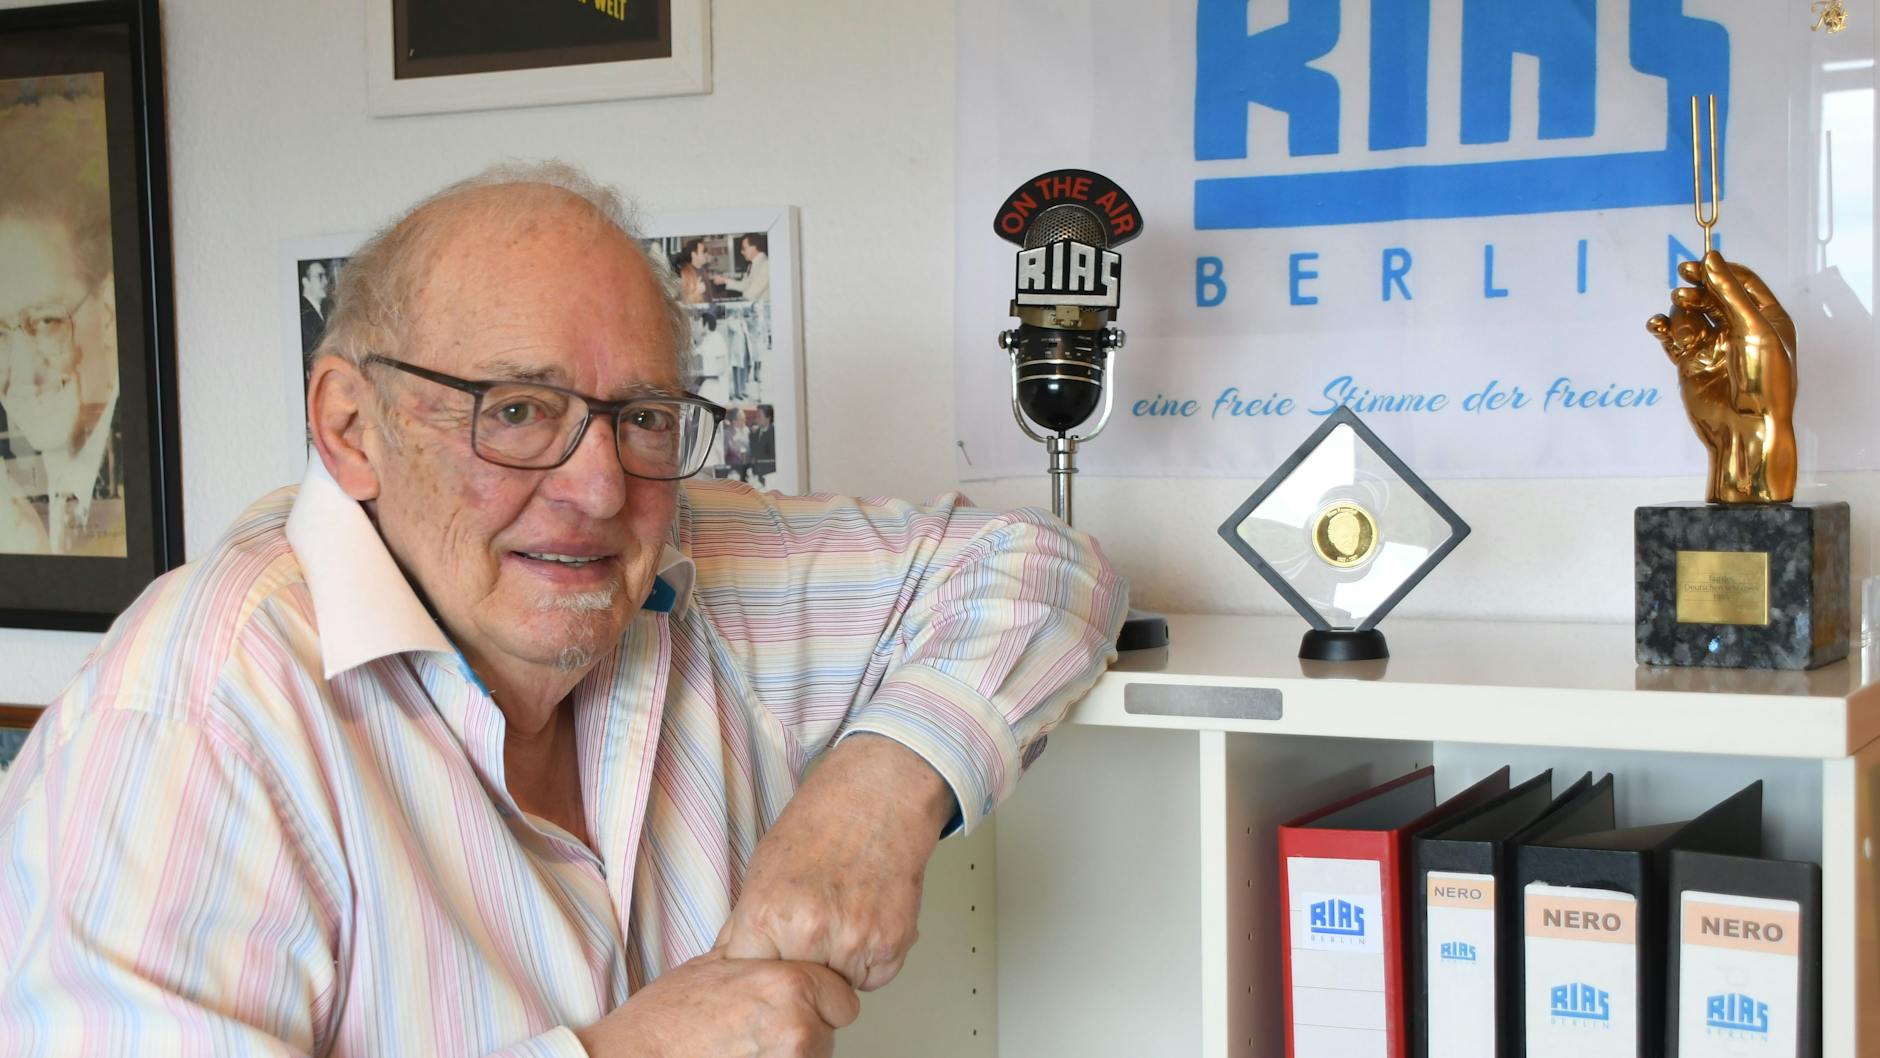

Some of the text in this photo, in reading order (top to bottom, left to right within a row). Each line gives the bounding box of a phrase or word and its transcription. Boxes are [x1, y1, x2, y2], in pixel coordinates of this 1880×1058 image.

[1002, 175, 1134, 236] ON THE AIR
[1017, 241, 1121, 307] RIAS
[1132, 375, 1661, 420] eine freie Stimme der freien
[1434, 886, 1482, 900] NERO
[1310, 898, 1365, 936] RIAS
[1543, 908, 1622, 932] NERO
[1701, 916, 1783, 942] NERO
[1440, 941, 1476, 961] RIAS
[1551, 982, 1609, 1021] RIAS
[1706, 992, 1768, 1033] RIAS
